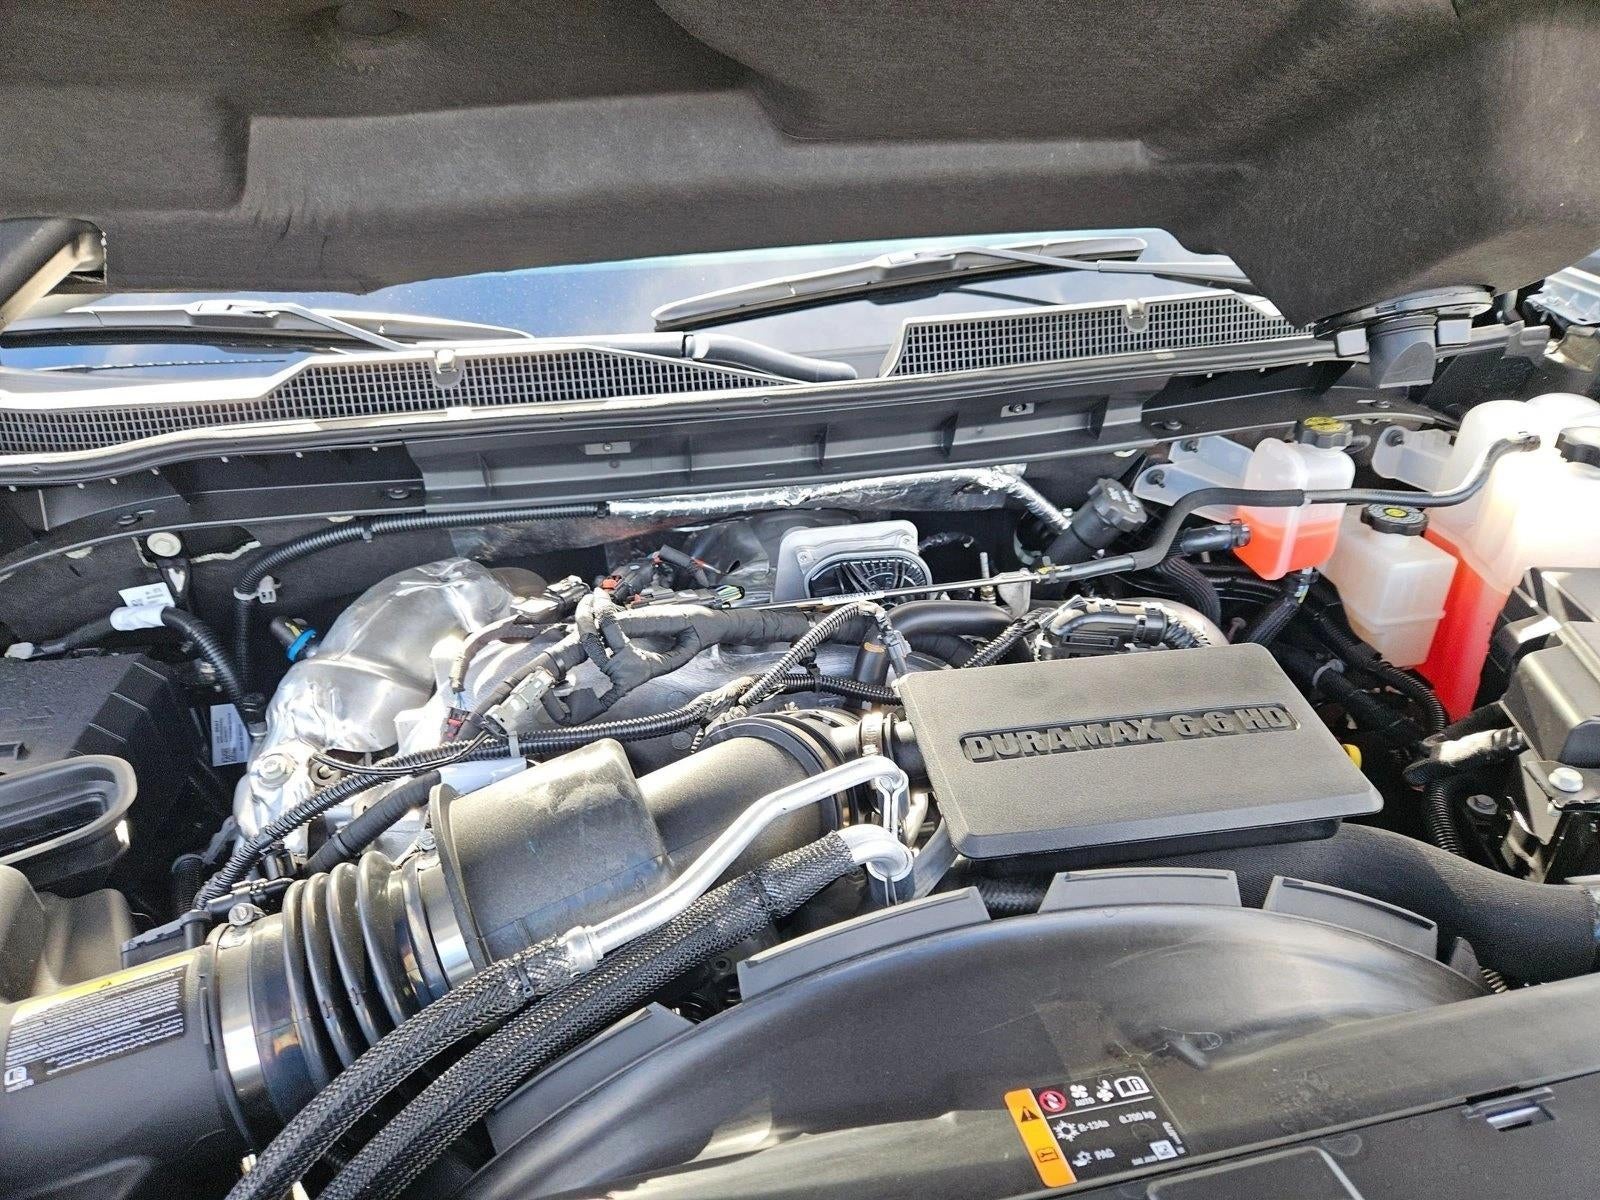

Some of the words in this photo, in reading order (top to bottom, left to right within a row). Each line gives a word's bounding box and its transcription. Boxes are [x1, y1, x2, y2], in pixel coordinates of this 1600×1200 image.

[964, 717, 1164, 761] DURAMAX
[1169, 711, 1233, 736] 6.6
[1234, 705, 1292, 730] HD
[1075, 1097, 1095, 1107] AUTO
[1094, 1148, 1115, 1160] PAG
